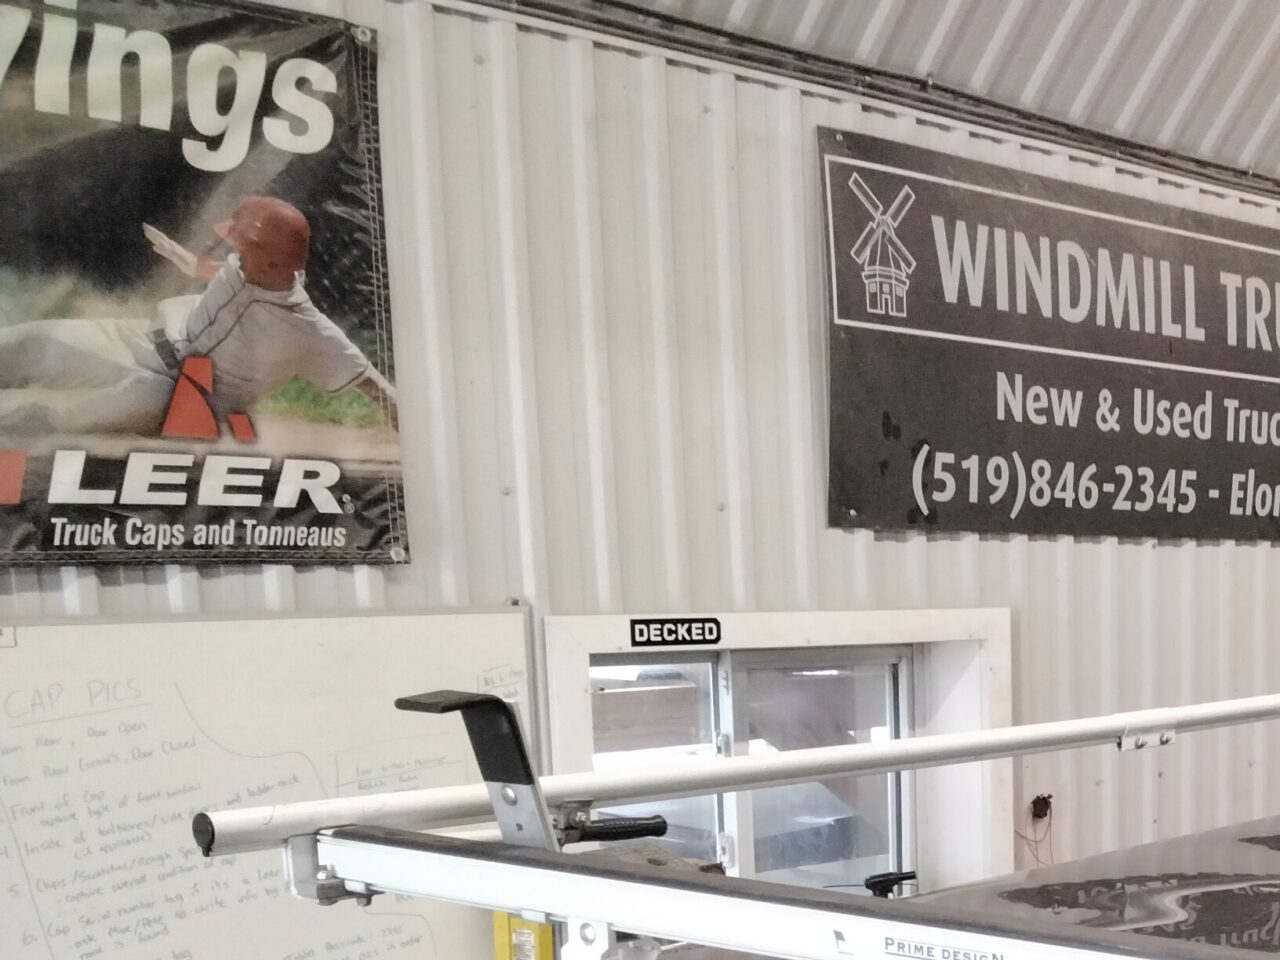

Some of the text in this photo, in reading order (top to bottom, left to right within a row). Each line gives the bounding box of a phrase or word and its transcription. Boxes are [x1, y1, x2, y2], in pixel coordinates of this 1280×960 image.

[931, 213, 1205, 343] WINDMILL
[995, 371, 1082, 429] New
[1095, 389, 1120, 432] &
[1133, 390, 1212, 440] Used
[47, 449, 344, 514] LEER
[911, 444, 1197, 519] (519)846-2345
[51, 518, 346, 550] Truck Caps and Tonneaus
[634, 622, 718, 642] DECKED
[4, 677, 142, 719] CAP PICS
[884, 936, 935, 958] PRIME
